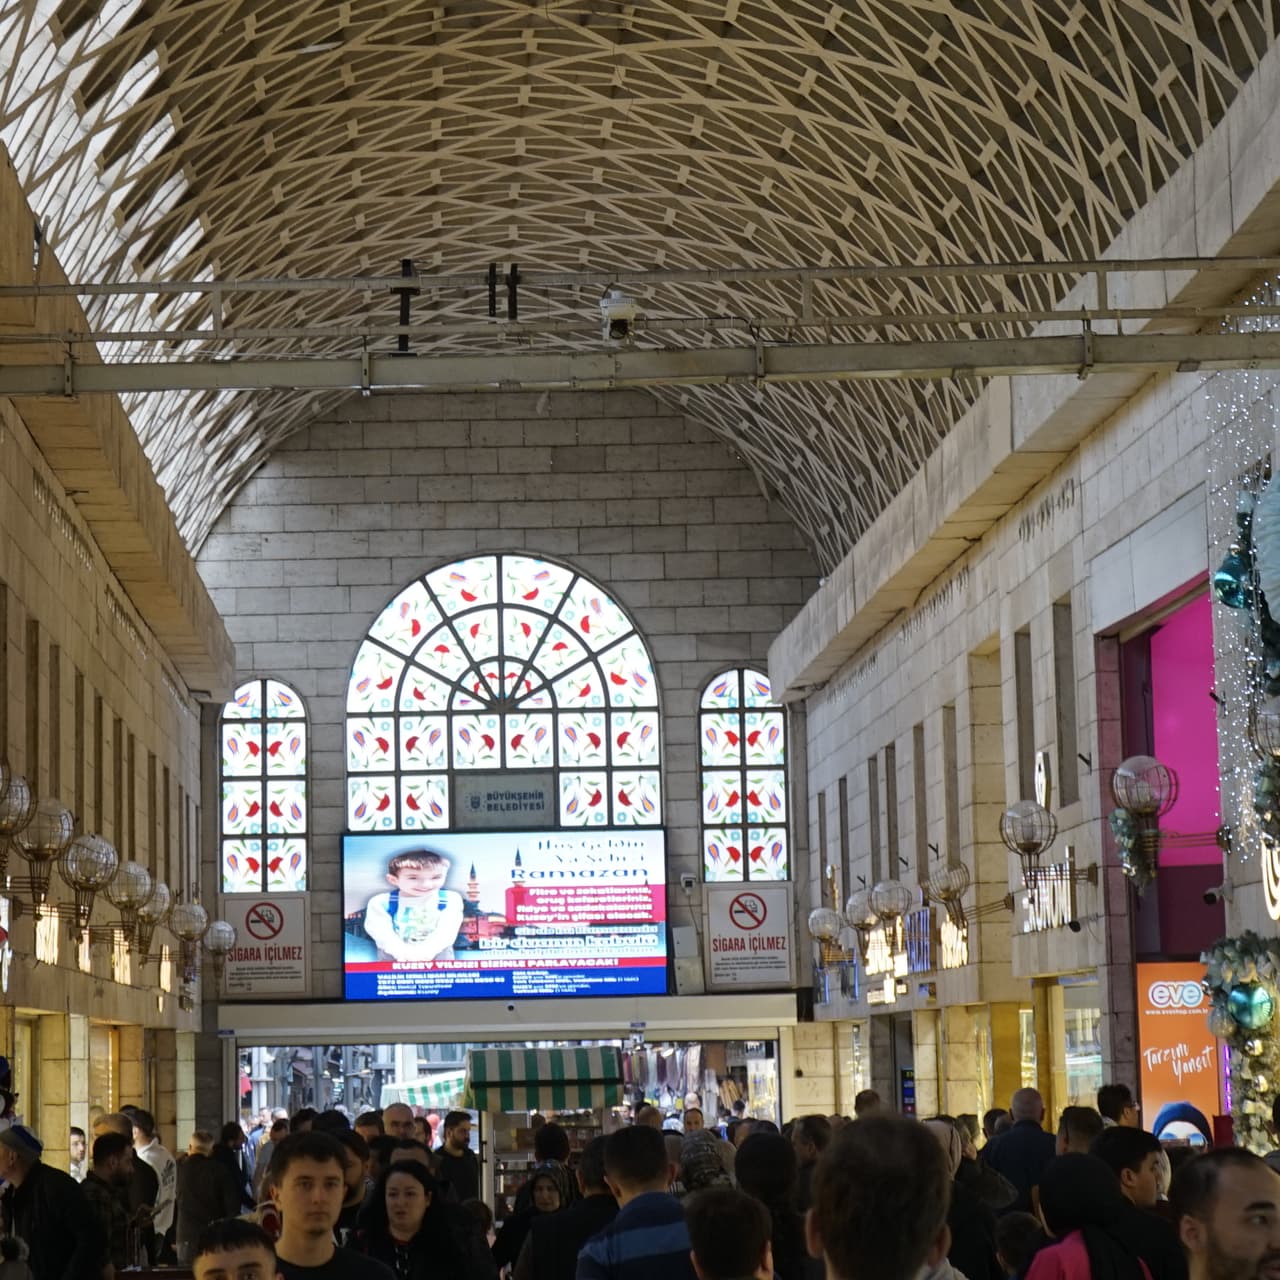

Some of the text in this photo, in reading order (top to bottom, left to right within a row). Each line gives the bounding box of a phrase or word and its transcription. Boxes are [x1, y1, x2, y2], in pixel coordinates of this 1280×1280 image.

[487, 801, 544, 813] BELEDİYESİ
[511, 868, 649, 880] Ramazan
[529, 888, 558, 896] Fitre
[559, 888, 575, 896] ve
[550, 905, 566, 913] ve
[479, 936, 509, 948] bir
[712, 932, 787, 956] SİGARA İÇİLMEZ
[263, 942, 303, 966] İÇİLMEZ
[392, 962, 434, 970] KUZEY
[480, 960, 525, 968] SİZİNLE
[527, 958, 619, 967] PARLAYACAK!
[1150, 982, 1203, 1008] eve
[1172, 1045, 1214, 1086] Yansıt
